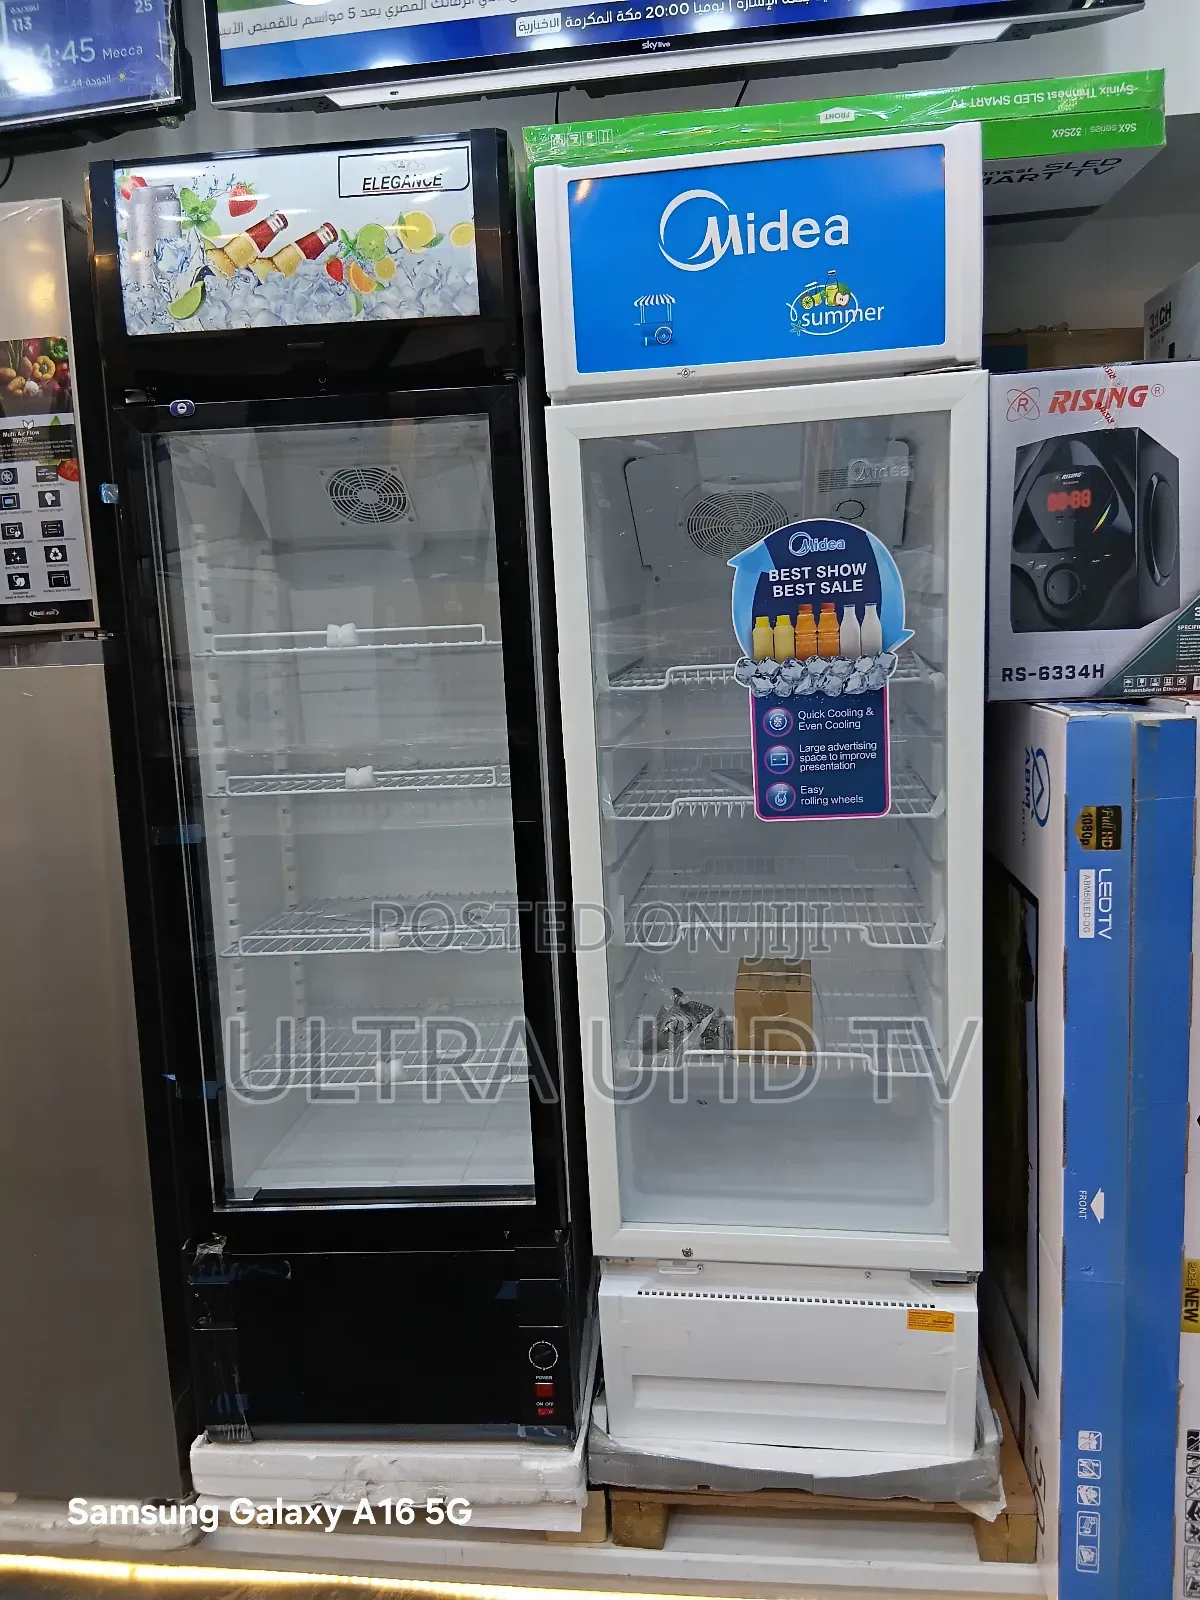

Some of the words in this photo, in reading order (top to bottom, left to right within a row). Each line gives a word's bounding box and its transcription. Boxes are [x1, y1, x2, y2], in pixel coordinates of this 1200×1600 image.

[135, 0, 153, 14] 25
[348, 7, 356, 19] 5
[360, 7, 382, 18] بعد
[645, 2, 690, 19] 20:00
[302, 12, 344, 29] مواسم
[565, 10, 613, 29] المكرمة
[616, 8, 642, 22] مكة
[12, 17, 33, 33] 113
[248, 16, 298, 36] بالقميص
[518, 17, 560, 34] الإخبارية
[102, 45, 144, 60] Mecca
[1046, 87, 1097, 101] Thinnest
[1099, 82, 1135, 97] Syinix
[969, 95, 1011, 108] SMART
[1013, 92, 1045, 104] SLED
[824, 111, 850, 120] FRONT
[1051, 127, 1082, 138] 32S6X
[1090, 124, 1117, 133] series
[1118, 123, 1137, 133] S6X
[1042, 158, 1123, 172] SLED
[1072, 166, 1116, 178] TV
[657, 188, 850, 272] Midea
[801, 304, 885, 328] summer
[1048, 384, 1149, 415] RISING
[788, 531, 846, 557] Midea
[768, 566, 812, 582] BEST
[816, 562, 867, 578] SHOW
[773, 582, 816, 598] BEST
[820, 579, 864, 594] SALE
[1001, 663, 1105, 682] RS-6334H
[798, 710, 826, 720] Quick
[827, 708, 864, 718] Cooling
[865, 707, 875, 716] &
[798, 722, 823, 731] Even
[825, 720, 861, 730] Cooling
[799, 744, 826, 754] Large
[827, 741, 877, 752] advertising
[799, 754, 827, 764] space
[829, 753, 838, 761] to
[839, 752, 877, 762] improve
[800, 762, 856, 773] presentation
[800, 785, 825, 795] Easy
[800, 796, 829, 807] rolling
[830, 795, 864, 804] wheels
[1101, 807, 1115, 829] Full
[1079, 812, 1093, 846] 1080p
[1101, 831, 1113, 848] HD
[1078, 1190, 1087, 1220] FRONT
[1187, 1262, 1197, 1287] 2025
[1184, 1287, 1200, 1324] NEW
